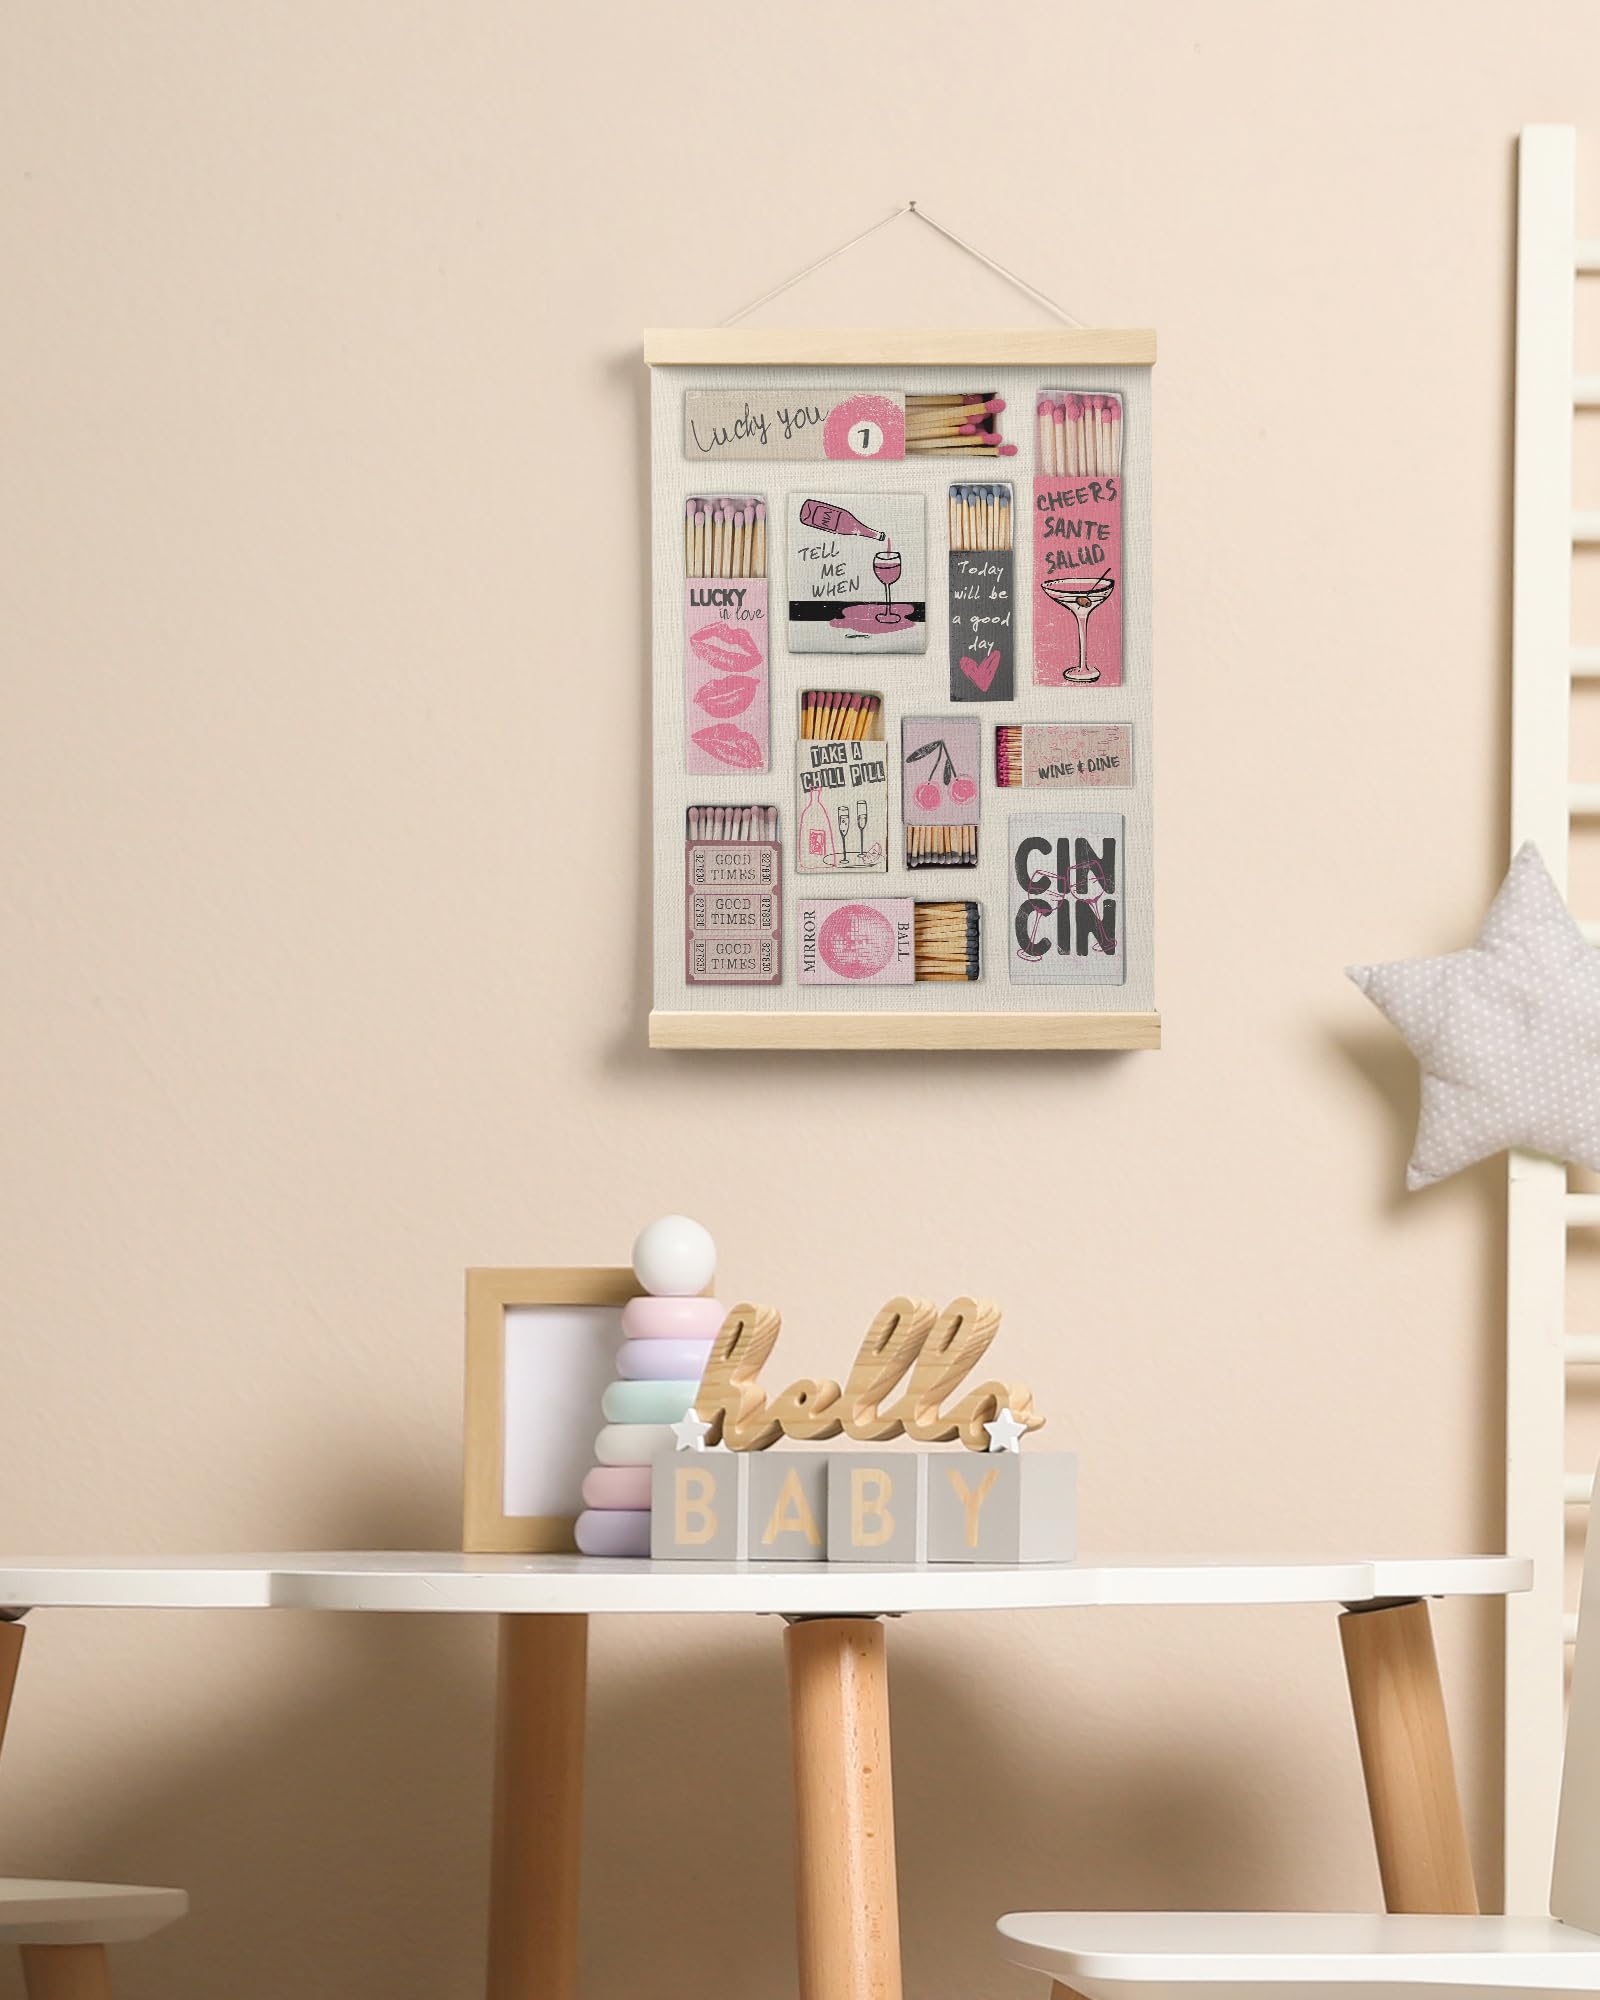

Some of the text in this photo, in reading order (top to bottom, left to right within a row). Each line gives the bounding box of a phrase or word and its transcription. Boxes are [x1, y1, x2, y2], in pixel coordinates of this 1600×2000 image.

[691, 402, 829, 452] Lucky you
[1036, 479, 1118, 512] CHEERS
[1043, 516, 1110, 541] SANTE
[798, 541, 840, 561] TELL
[1044, 543, 1105, 574] SALUD
[820, 562, 847, 579] ME
[957, 560, 1004, 582] Today
[690, 588, 747, 607] LUCKY
[812, 576, 860, 598] WHEN
[954, 585, 1009, 600] will be
[719, 607, 765, 621] in love
[952, 611, 1011, 633] a good
[968, 636, 995, 656] day
[810, 742, 862, 768] TAKE A
[800, 761, 885, 793] CHILL PILL
[1038, 763, 1074, 780] WINE
[1087, 756, 1120, 773] DINE
[715, 854, 751, 866] GOOD
[1014, 836, 1116, 895] CIN
[711, 869, 756, 881] TIMES
[716, 898, 751, 910] GOOD
[711, 913, 756, 925] TIMES
[1014, 898, 1116, 957] CIN
[716, 943, 751, 955] GOOD
[803, 909, 816, 974] MIRROR
[897, 921, 910, 962] BALL
[711, 958, 756, 970] TIMES
[692, 1296, 1046, 1452] hello
[674, 1466, 1000, 1547] BABY
